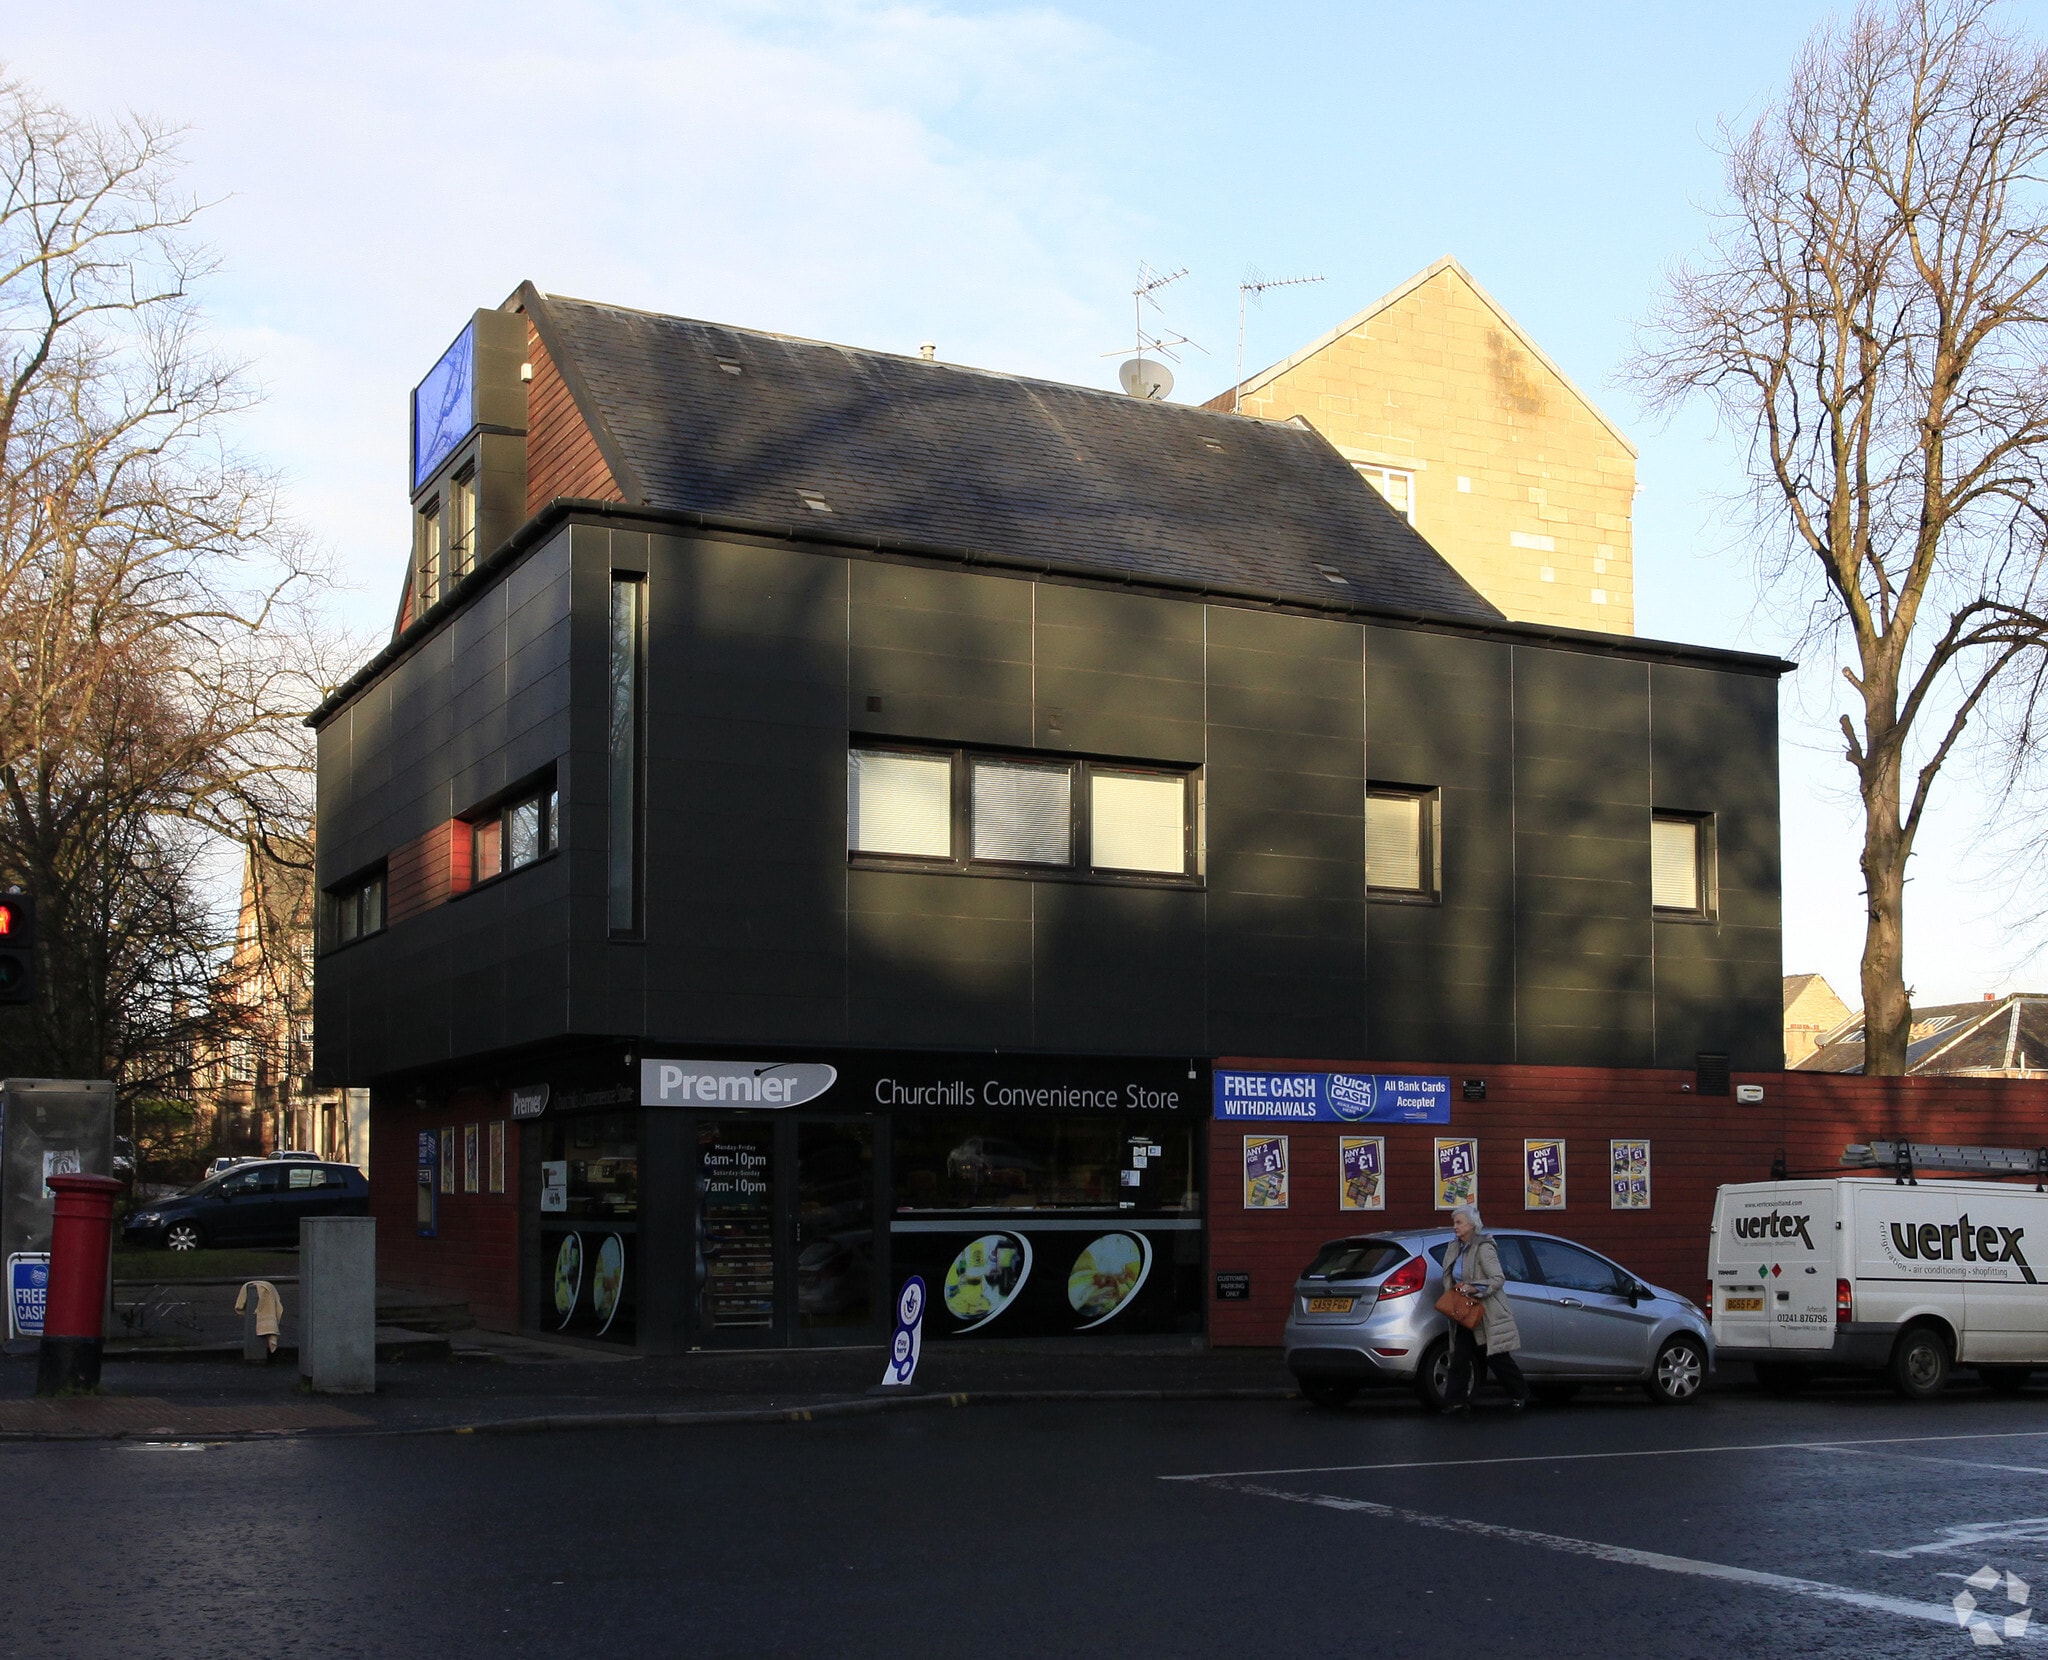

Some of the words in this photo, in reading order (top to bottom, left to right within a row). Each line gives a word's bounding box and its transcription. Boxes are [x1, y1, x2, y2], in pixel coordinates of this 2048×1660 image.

[660, 1065, 798, 1103] Premier
[1224, 1076, 1268, 1097] FREE
[1270, 1077, 1316, 1098] CASH
[1333, 1074, 1372, 1093] QUICK
[1384, 1080, 1396, 1091] All
[1398, 1080, 1420, 1092] Bank
[1421, 1081, 1446, 1093] Cards
[875, 1078, 976, 1106] Churchills
[983, 1081, 1118, 1109] Convenience
[1126, 1084, 1179, 1110] Store
[1333, 1086, 1369, 1106] CASH
[513, 1091, 542, 1116] Premier
[1224, 1100, 1317, 1117] WITHDRAWALS
[1336, 1101, 1364, 1113] AVAILABLE
[1396, 1096, 1436, 1110] Accepted
[714, 1144, 756, 1152] Monday-Friday
[1247, 1146, 1262, 1157] ANY
[1263, 1144, 1269, 1153] 2
[1345, 1148, 1360, 1158] ANY
[1359, 1147, 1365, 1155] 4
[1440, 1148, 1455, 1158] ANY
[1455, 1146, 1460, 1154] 2
[1533, 1148, 1551, 1159] ONLY
[1634, 1150, 1643, 1160] £1
[703, 1152, 767, 1169] 6am-10pm
[1247, 1155, 1259, 1163] FOR
[1264, 1149, 1281, 1172] £1
[1345, 1156, 1356, 1165] FOR
[1358, 1153, 1373, 1170] £1
[1440, 1156, 1451, 1164] FOR
[1451, 1151, 1470, 1175] £1
[1531, 1157, 1549, 1176] £1
[713, 1169, 760, 1177] Saturday-Sunday
[703, 1178, 767, 1196] 7am-10pm
[1618, 1182, 1627, 1192] £1
[1632, 1183, 1641, 1193] £1
[1744, 1200, 1803, 1208] www.vertexscotland.com
[1736, 1209, 1815, 1250] vertex
[1879, 1221, 1907, 1273] refrigeration
[1913, 1266, 1924, 1274] air
[1924, 1266, 1967, 1278] conditioning
[1972, 1266, 2008, 1279] shopfitting
[1890, 1213, 2038, 1285] vertex
[16, 1288, 47, 1304] FREE
[1746, 1299, 1761, 1310] FJP
[17, 1305, 46, 1321] CASH
[1777, 1313, 1797, 1323] 01241
[1799, 1314, 1828, 1323] 876796
